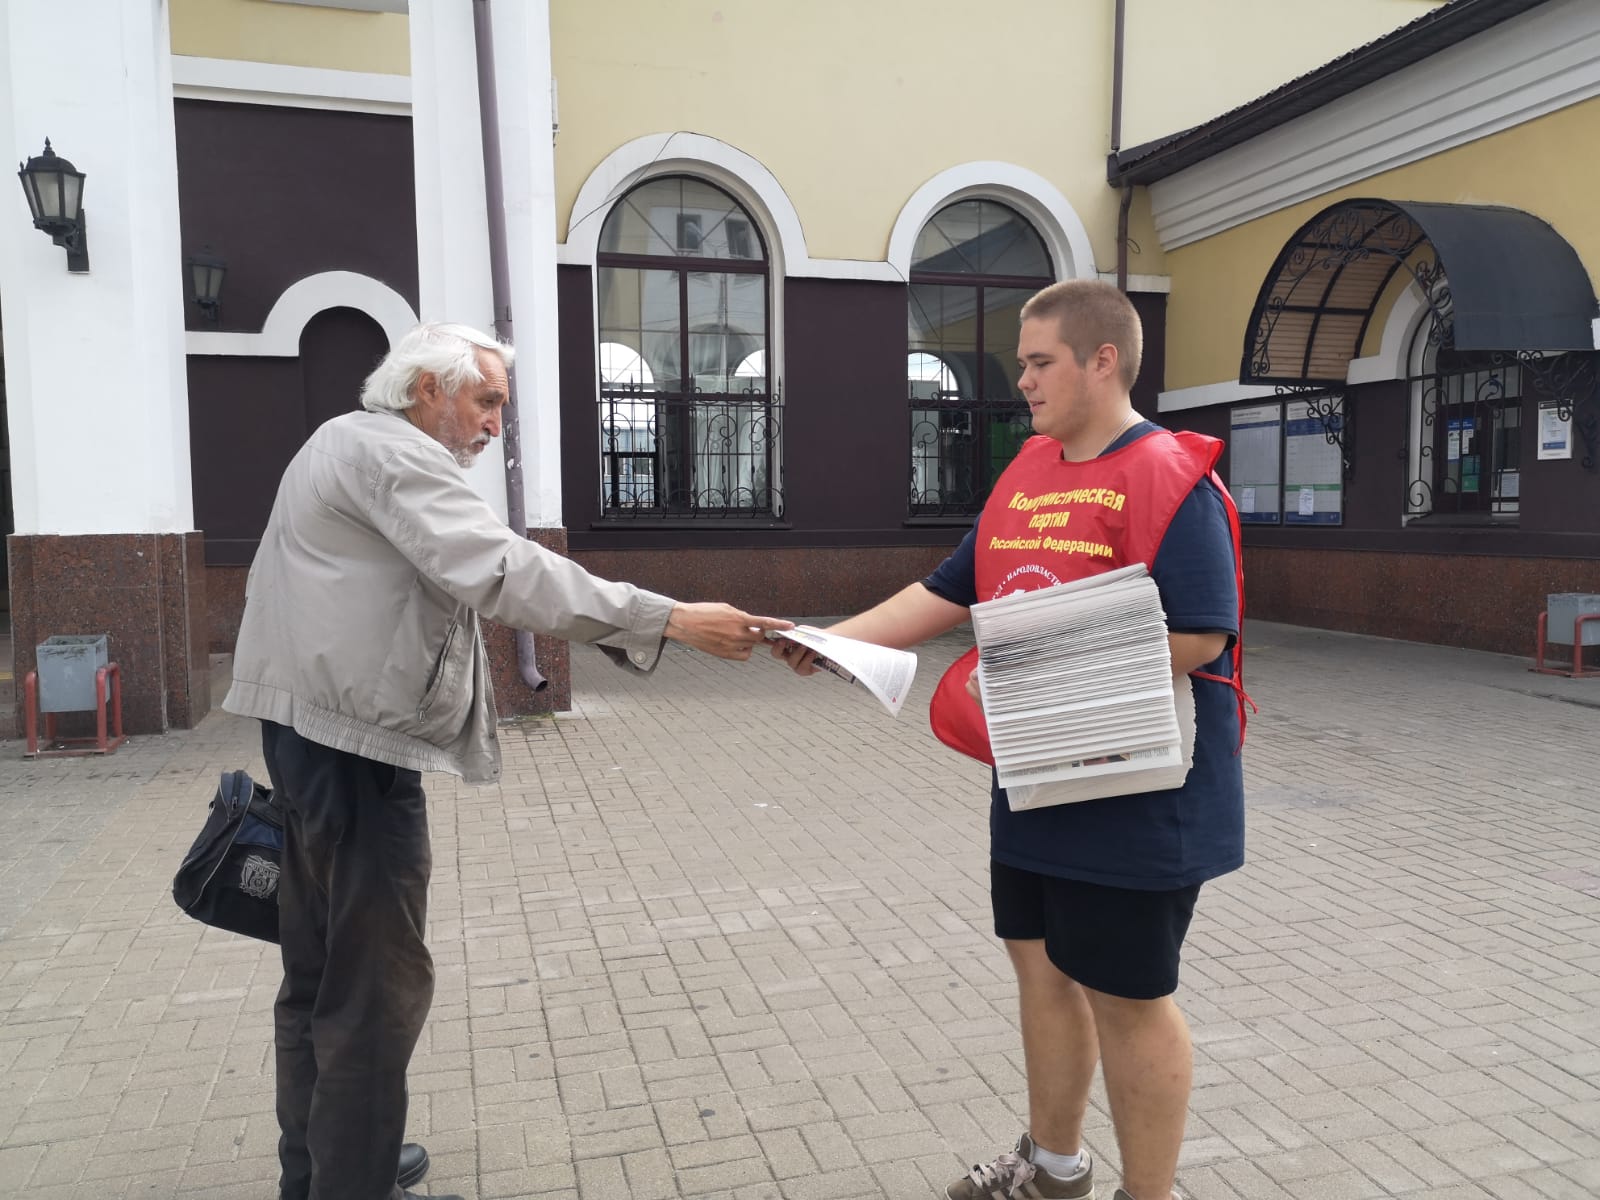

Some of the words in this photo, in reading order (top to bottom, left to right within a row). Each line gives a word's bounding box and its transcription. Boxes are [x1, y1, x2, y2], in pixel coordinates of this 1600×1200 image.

[1028, 511, 1071, 533] партия
[989, 536, 1042, 550] Российской
[1043, 535, 1113, 558] Федерации
